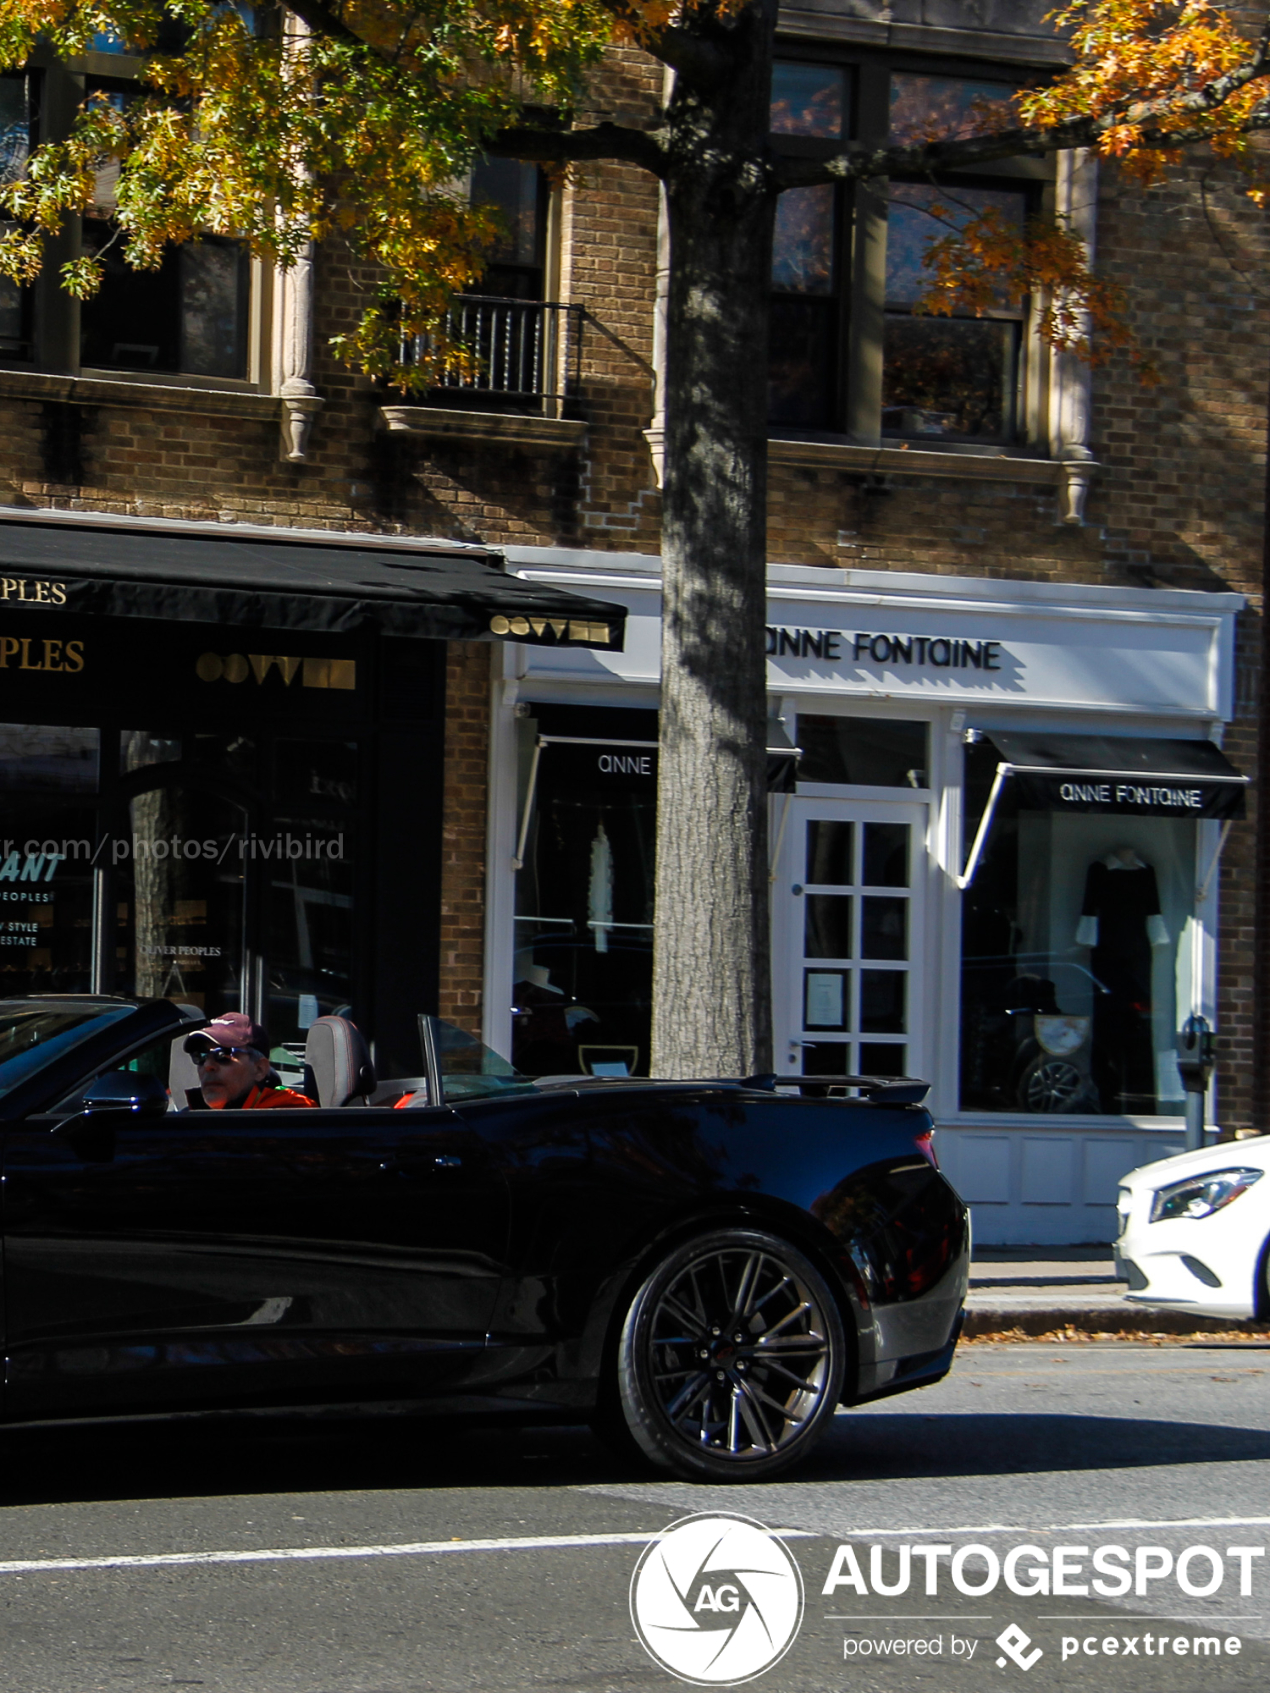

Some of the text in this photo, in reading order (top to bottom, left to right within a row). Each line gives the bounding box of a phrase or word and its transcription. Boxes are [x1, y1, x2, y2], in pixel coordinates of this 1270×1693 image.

[8, 921, 39, 932] STYLE
[0, 935, 37, 946] ESTATE
[140, 944, 221, 957] OLIVER PEOPLES
